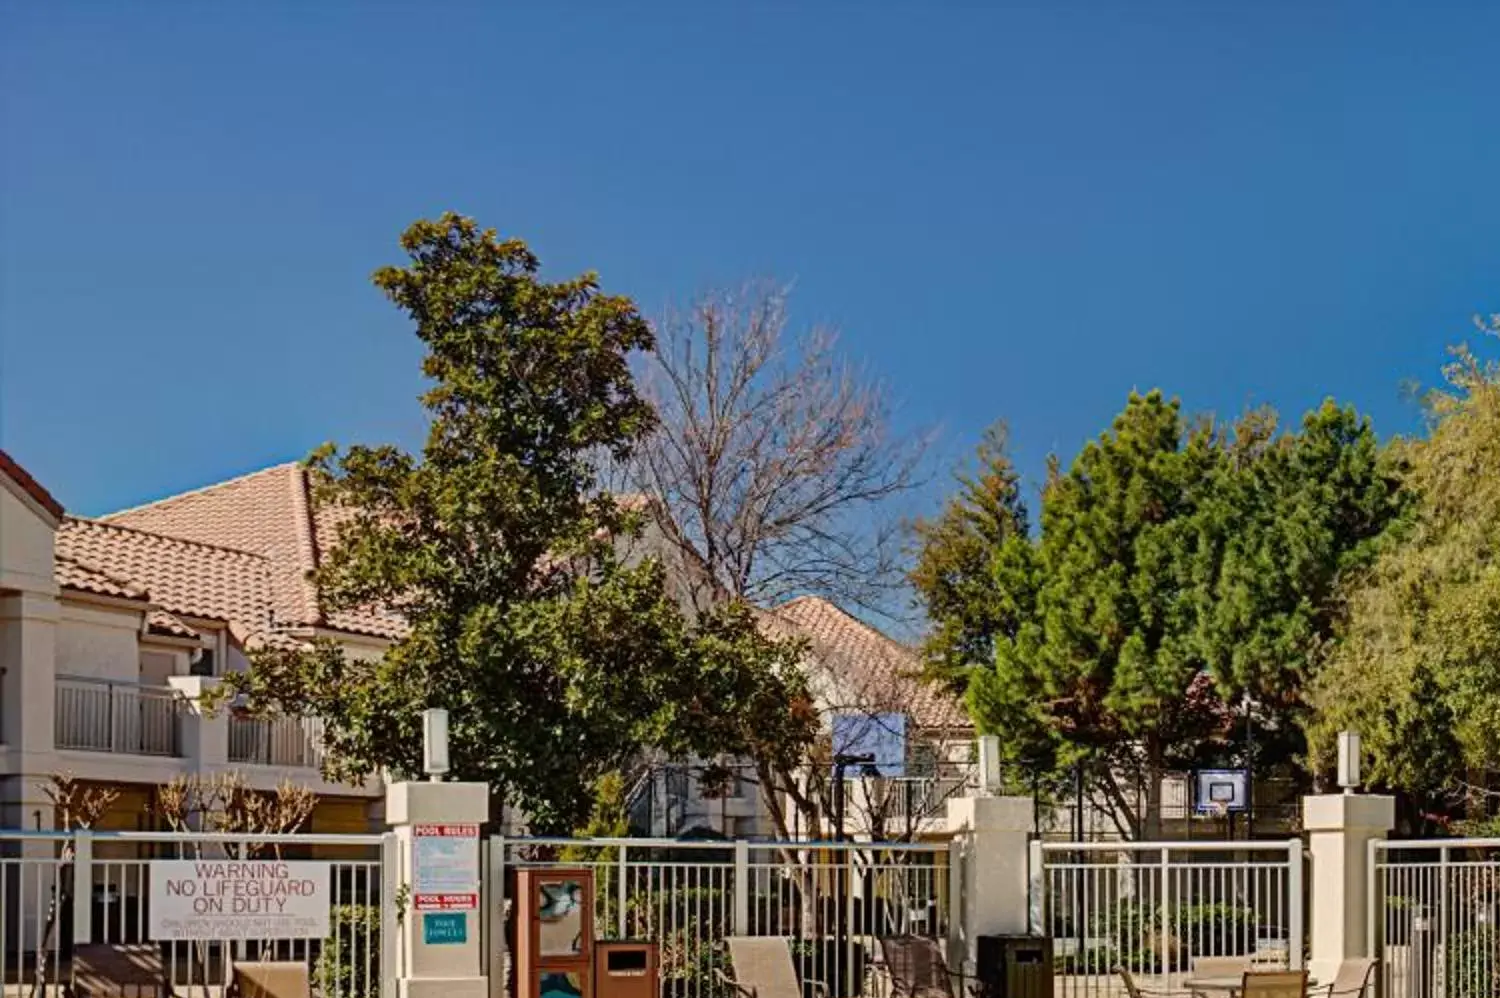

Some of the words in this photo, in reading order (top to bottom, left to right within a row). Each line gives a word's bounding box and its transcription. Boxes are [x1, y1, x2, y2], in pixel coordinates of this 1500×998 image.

[416, 825, 441, 836] POOL
[195, 863, 289, 879] WARNING
[166, 879, 196, 896] NO
[203, 879, 315, 896] LIFEGUARD
[193, 897, 223, 913] ON
[232, 897, 287, 913] DUTY
